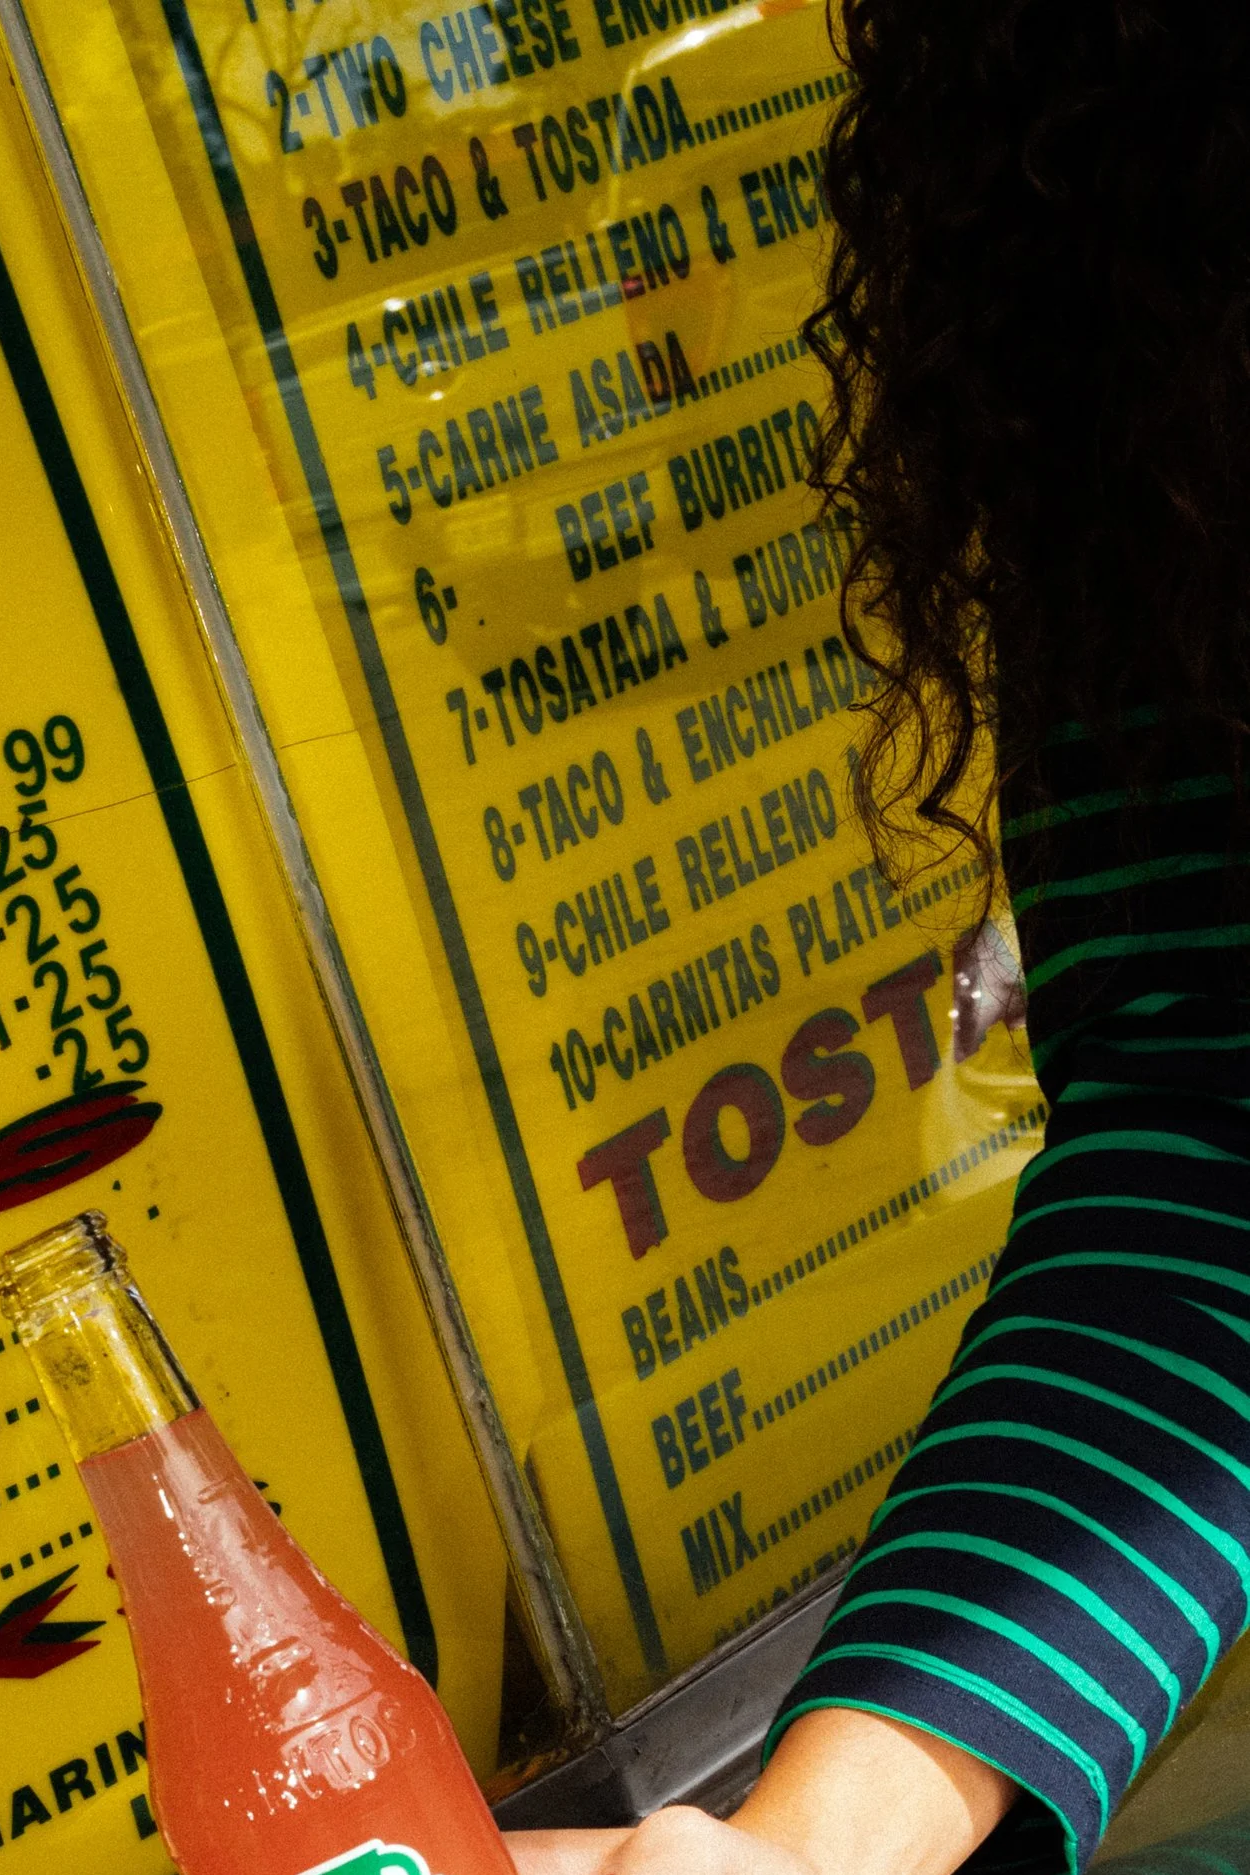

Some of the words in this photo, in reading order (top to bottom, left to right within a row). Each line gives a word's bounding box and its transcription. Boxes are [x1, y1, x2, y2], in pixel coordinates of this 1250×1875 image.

[265, 35, 407, 155] 2-TWO
[419, 0, 582, 102] CHEESE
[302, 153, 457, 280] 3-TACO
[470, 137, 509, 222] &
[514, 76, 695, 201] TOSTADA
[345, 271, 510, 400] 4-CHILE
[515, 203, 691, 336] RELLENO
[701, 184, 737, 265] &
[376, 384, 558, 525] 5-CARNE
[568, 329, 700, 447] ASADA
[555, 472, 656, 583] BEEF
[445, 593, 690, 766] 7-TOSATADA
[693, 568, 730, 649] &
[482, 750, 624, 882] 8-TACO
[635, 727, 673, 806] &
[514, 854, 671, 1000] 9-CHILE
[674, 767, 838, 912] RELLENO
[548, 929, 783, 1110] 10-CARNITAS
[787, 862, 904, 977] PLATE
[619, 1245, 753, 1382] BEANS
[650, 1367, 751, 1491] BEEF
[680, 1490, 758, 1598] MIX
